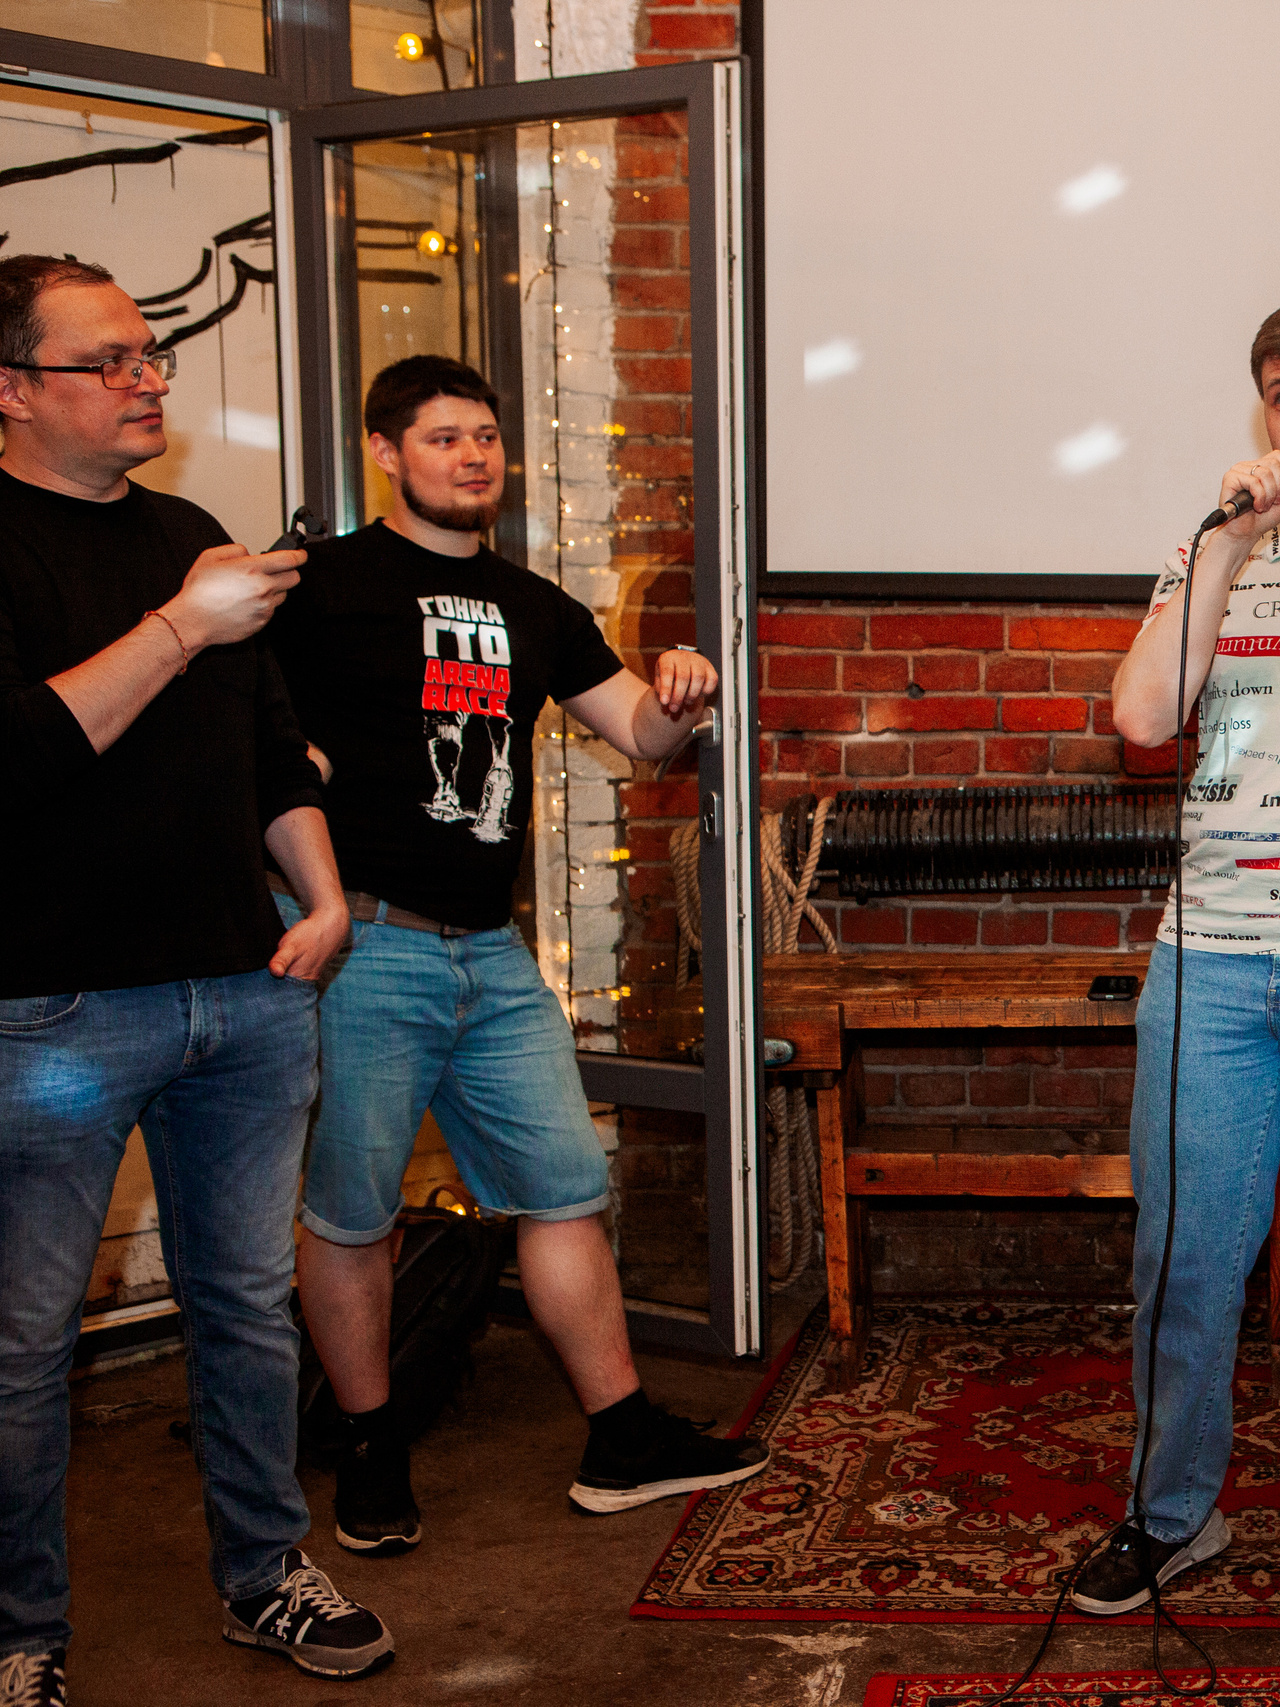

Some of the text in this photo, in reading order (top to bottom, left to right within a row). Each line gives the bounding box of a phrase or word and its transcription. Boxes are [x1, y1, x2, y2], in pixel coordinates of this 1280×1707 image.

[417, 595, 506, 626] ГОНКА
[423, 615, 513, 667] ГТО
[424, 658, 511, 694] ARENA
[1230, 680, 1273, 698] down
[422, 683, 509, 719] RACE
[1230, 717, 1251, 730] loss
